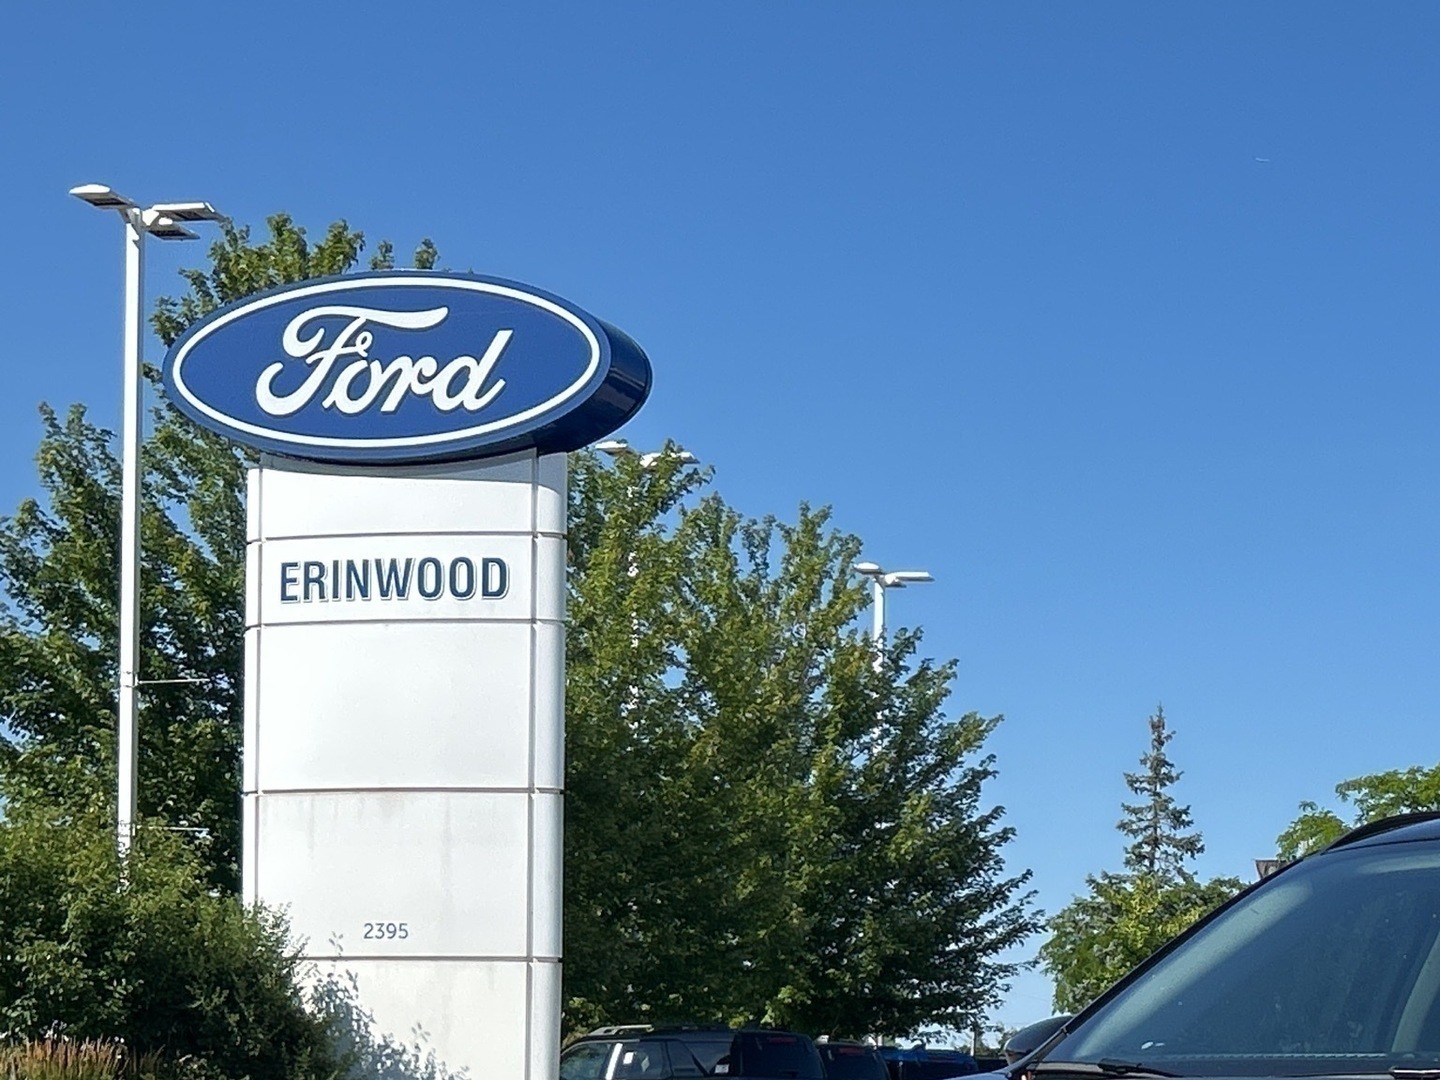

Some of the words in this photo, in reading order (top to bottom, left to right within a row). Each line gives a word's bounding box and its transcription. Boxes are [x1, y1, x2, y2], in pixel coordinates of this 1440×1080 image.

[256, 305, 514, 417] Ford
[280, 556, 509, 602] ERINWOOD
[363, 922, 409, 940] 2395
